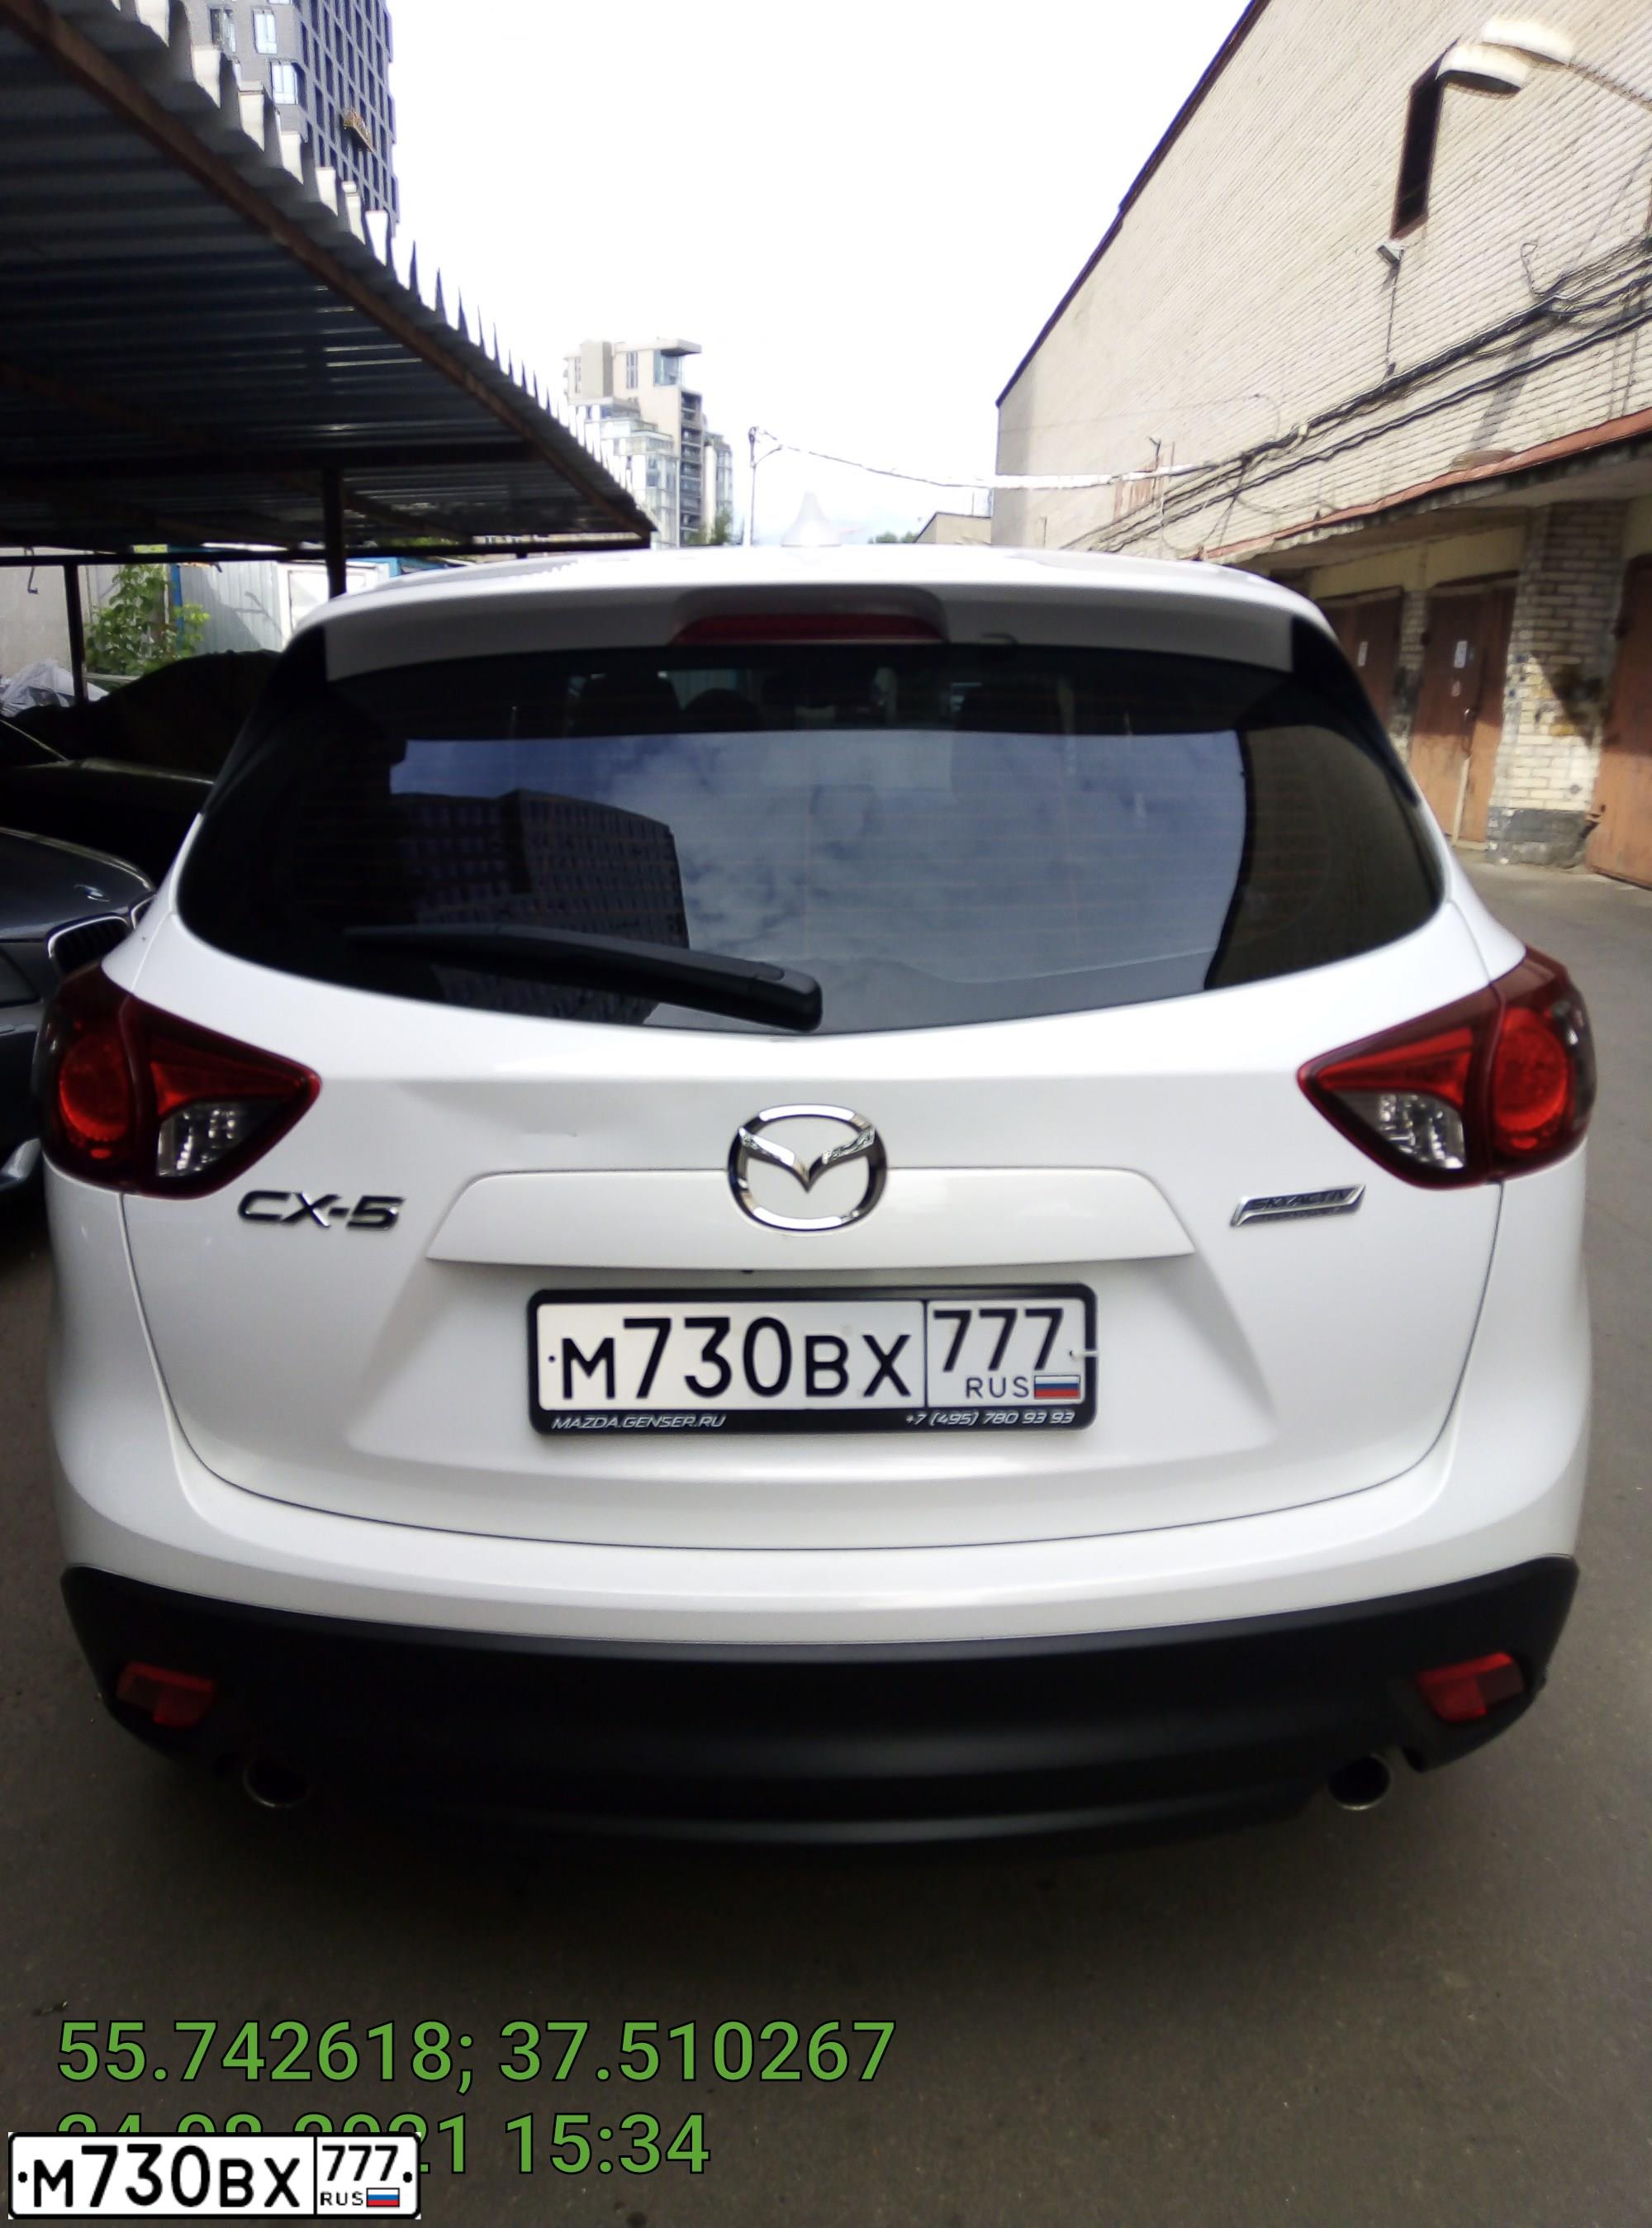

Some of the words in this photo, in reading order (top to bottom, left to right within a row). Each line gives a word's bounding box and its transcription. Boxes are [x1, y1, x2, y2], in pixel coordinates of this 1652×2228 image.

[238, 1190, 406, 1230] CX-5
[933, 1308, 1064, 1372] 777
[966, 1376, 1030, 1399] RUS
[552, 1413, 727, 1430] MAZDA.GENSER.RU
[905, 1413, 926, 1426] +7
[929, 1411, 979, 1426] (495)
[983, 1411, 1018, 1425] 780
[1022, 1411, 1048, 1425] 93
[1051, 1411, 1075, 1425] 93
